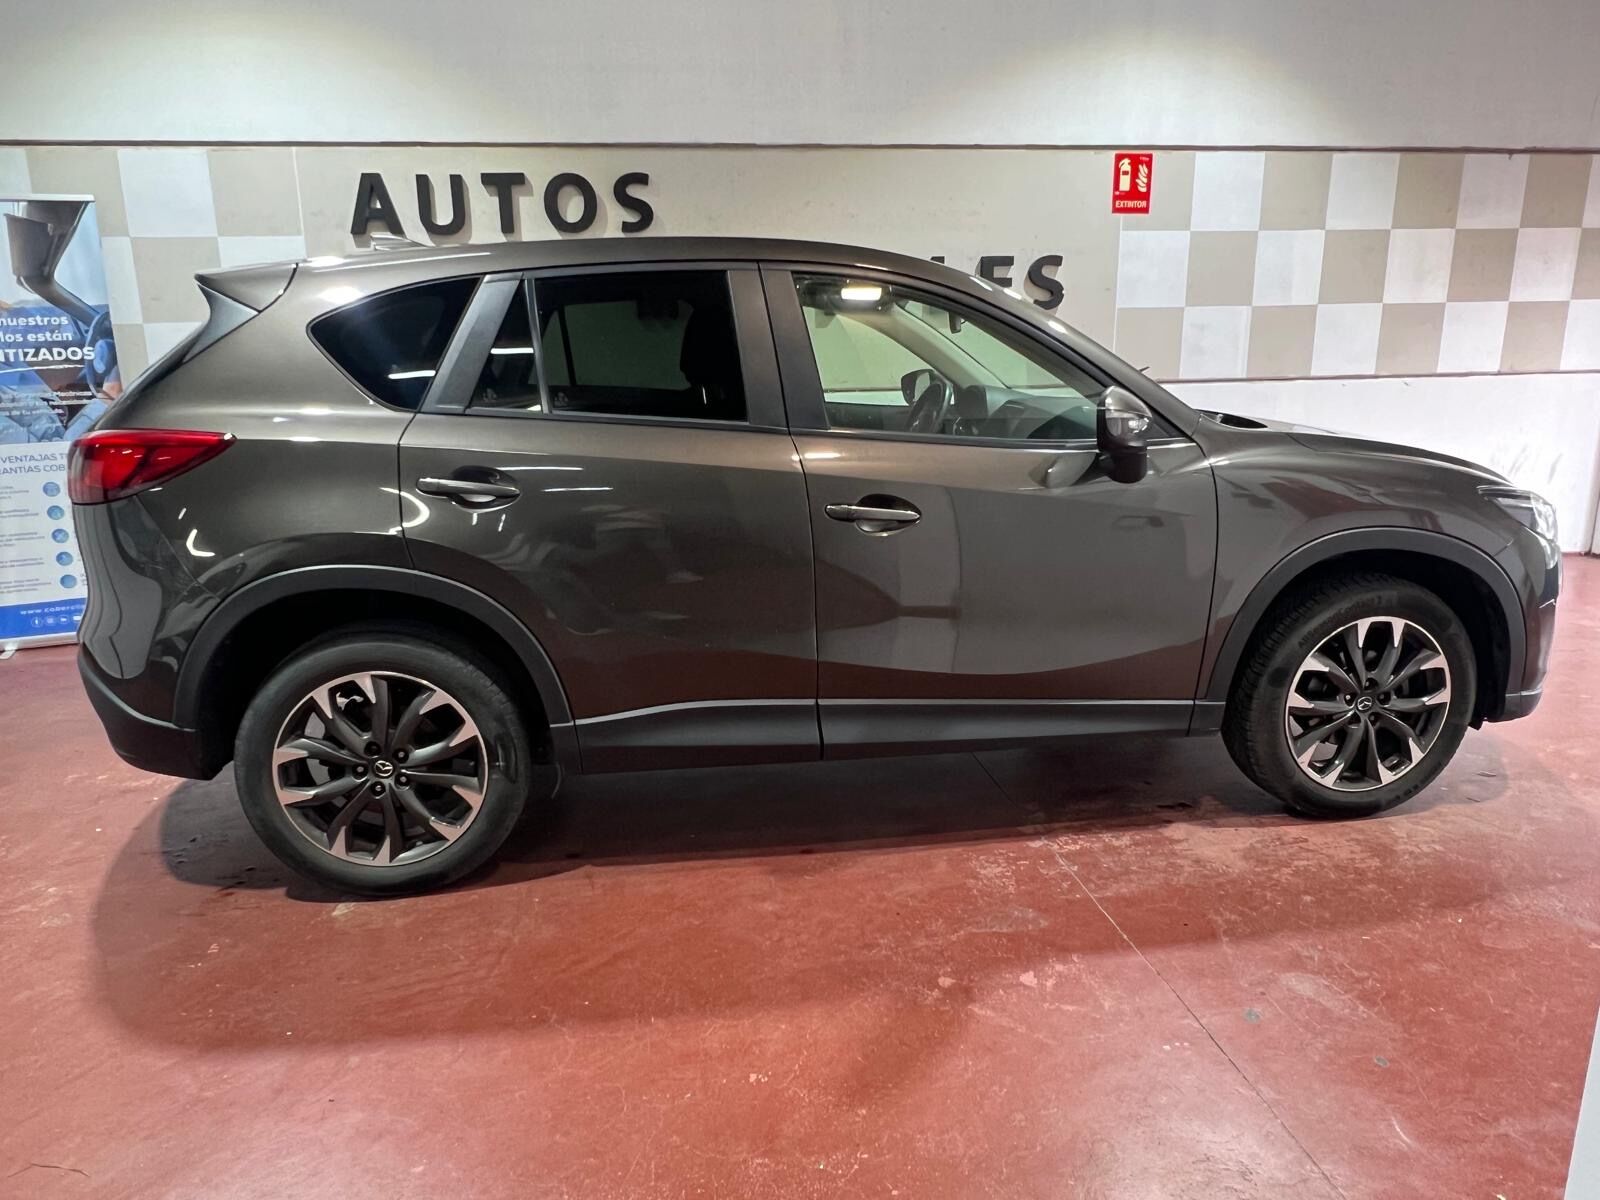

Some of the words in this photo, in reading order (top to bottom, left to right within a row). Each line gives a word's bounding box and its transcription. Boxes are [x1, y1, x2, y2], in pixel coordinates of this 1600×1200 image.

[350, 172, 654, 235] AUTOS
[1115, 200, 1147, 208] EXTINTOR
[27, 329, 72, 342] están
[0, 453, 57, 464] VENTAJAS
